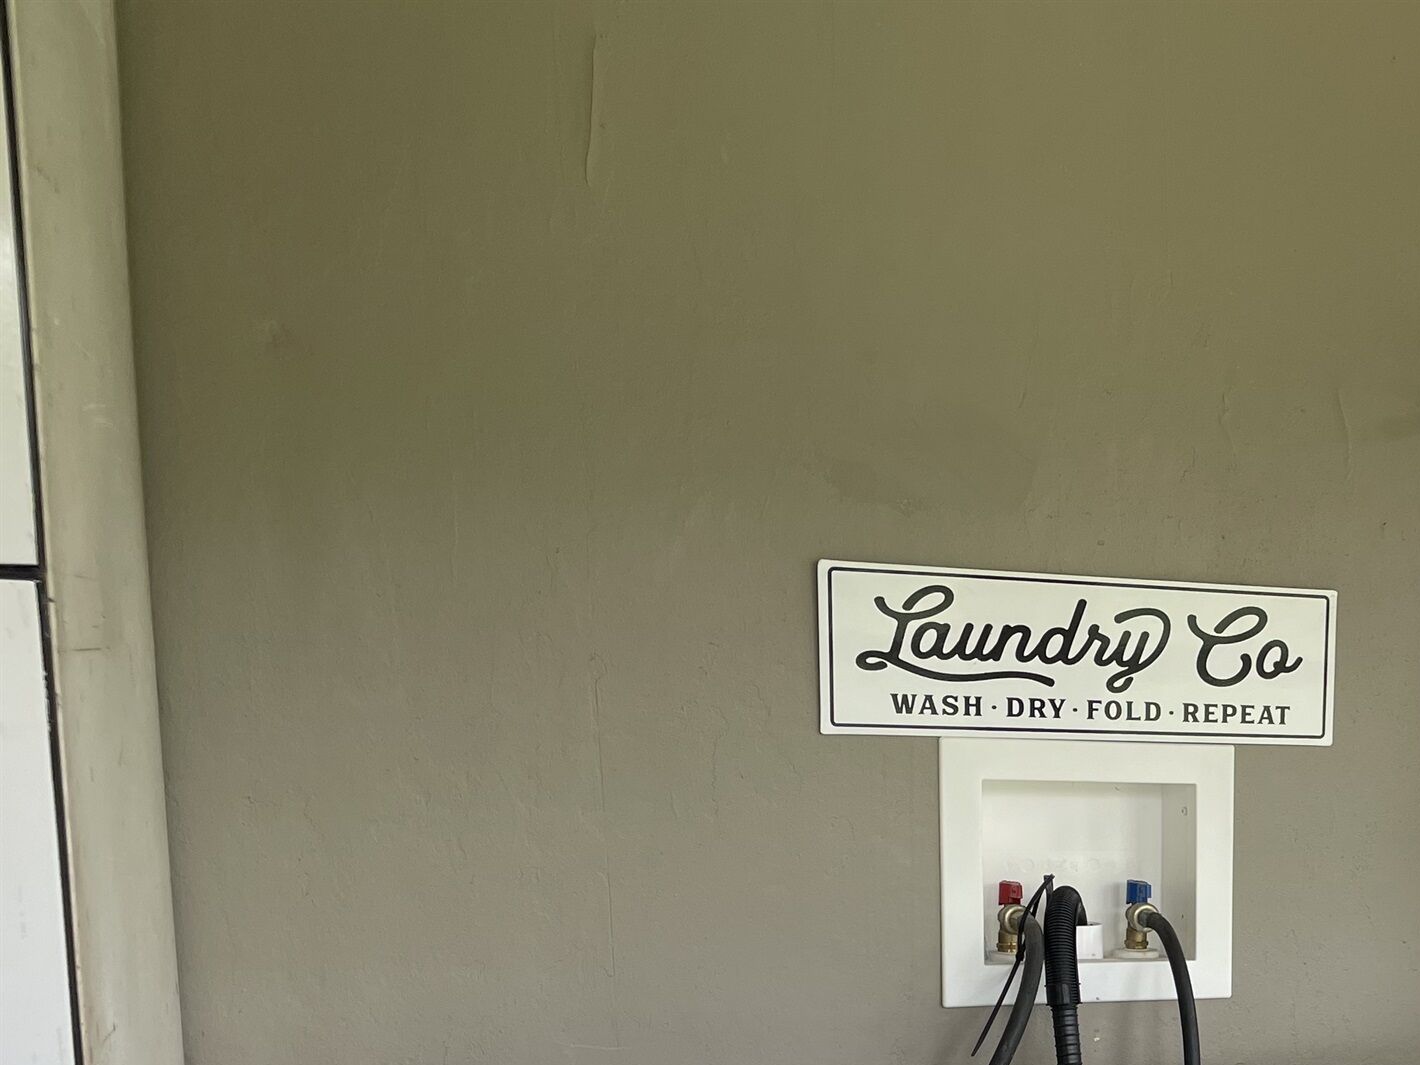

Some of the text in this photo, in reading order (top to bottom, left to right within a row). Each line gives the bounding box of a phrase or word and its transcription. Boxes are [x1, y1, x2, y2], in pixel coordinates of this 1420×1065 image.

[856, 585, 1302, 693] Laundry Co
[890, 693, 1290, 725] WASH DRY FOLD REPEAT
